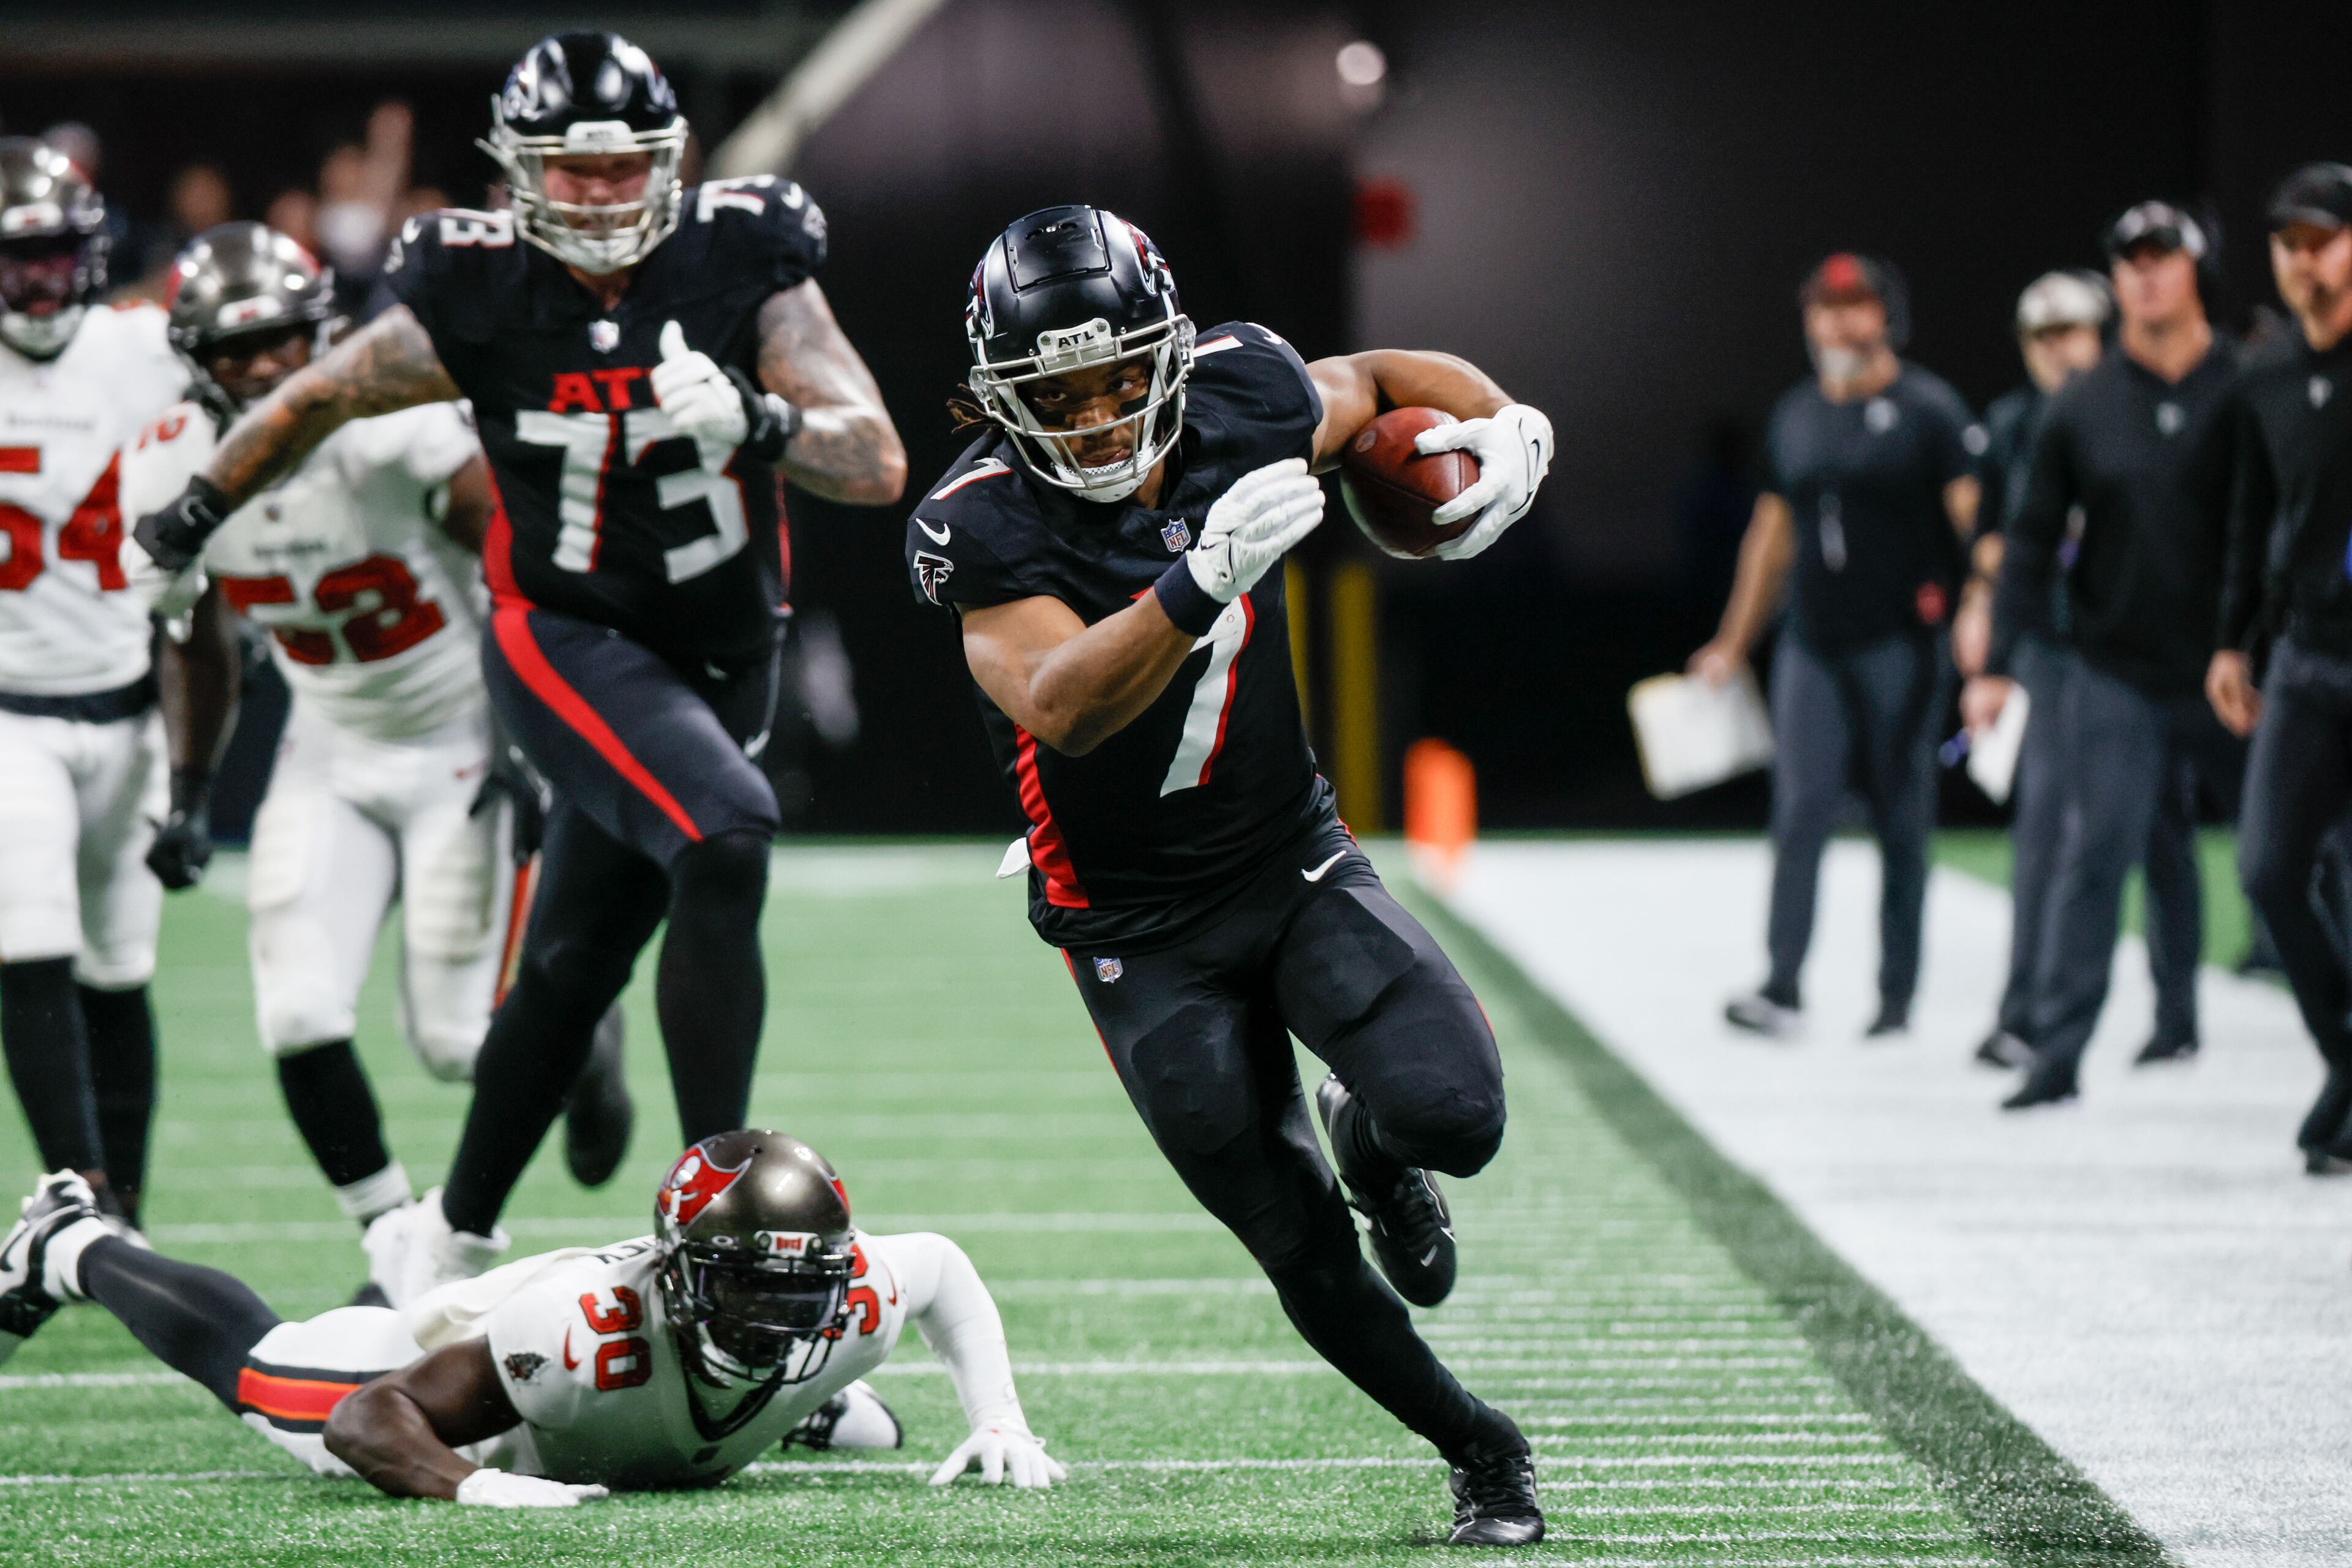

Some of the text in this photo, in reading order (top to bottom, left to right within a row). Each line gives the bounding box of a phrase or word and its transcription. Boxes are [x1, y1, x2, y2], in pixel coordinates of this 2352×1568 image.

[1058, 331, 1094, 348] ATL
[548, 367, 662, 413] AT
[516, 409, 748, 584] 73
[930, 458, 1014, 500] 7
[0, 446, 127, 591] 54
[1168, 532, 1187, 548] NFL
[1159, 592, 1255, 797] 7
[1099, 962, 1118, 978] NFL
[578, 1286, 652, 1392] 30
